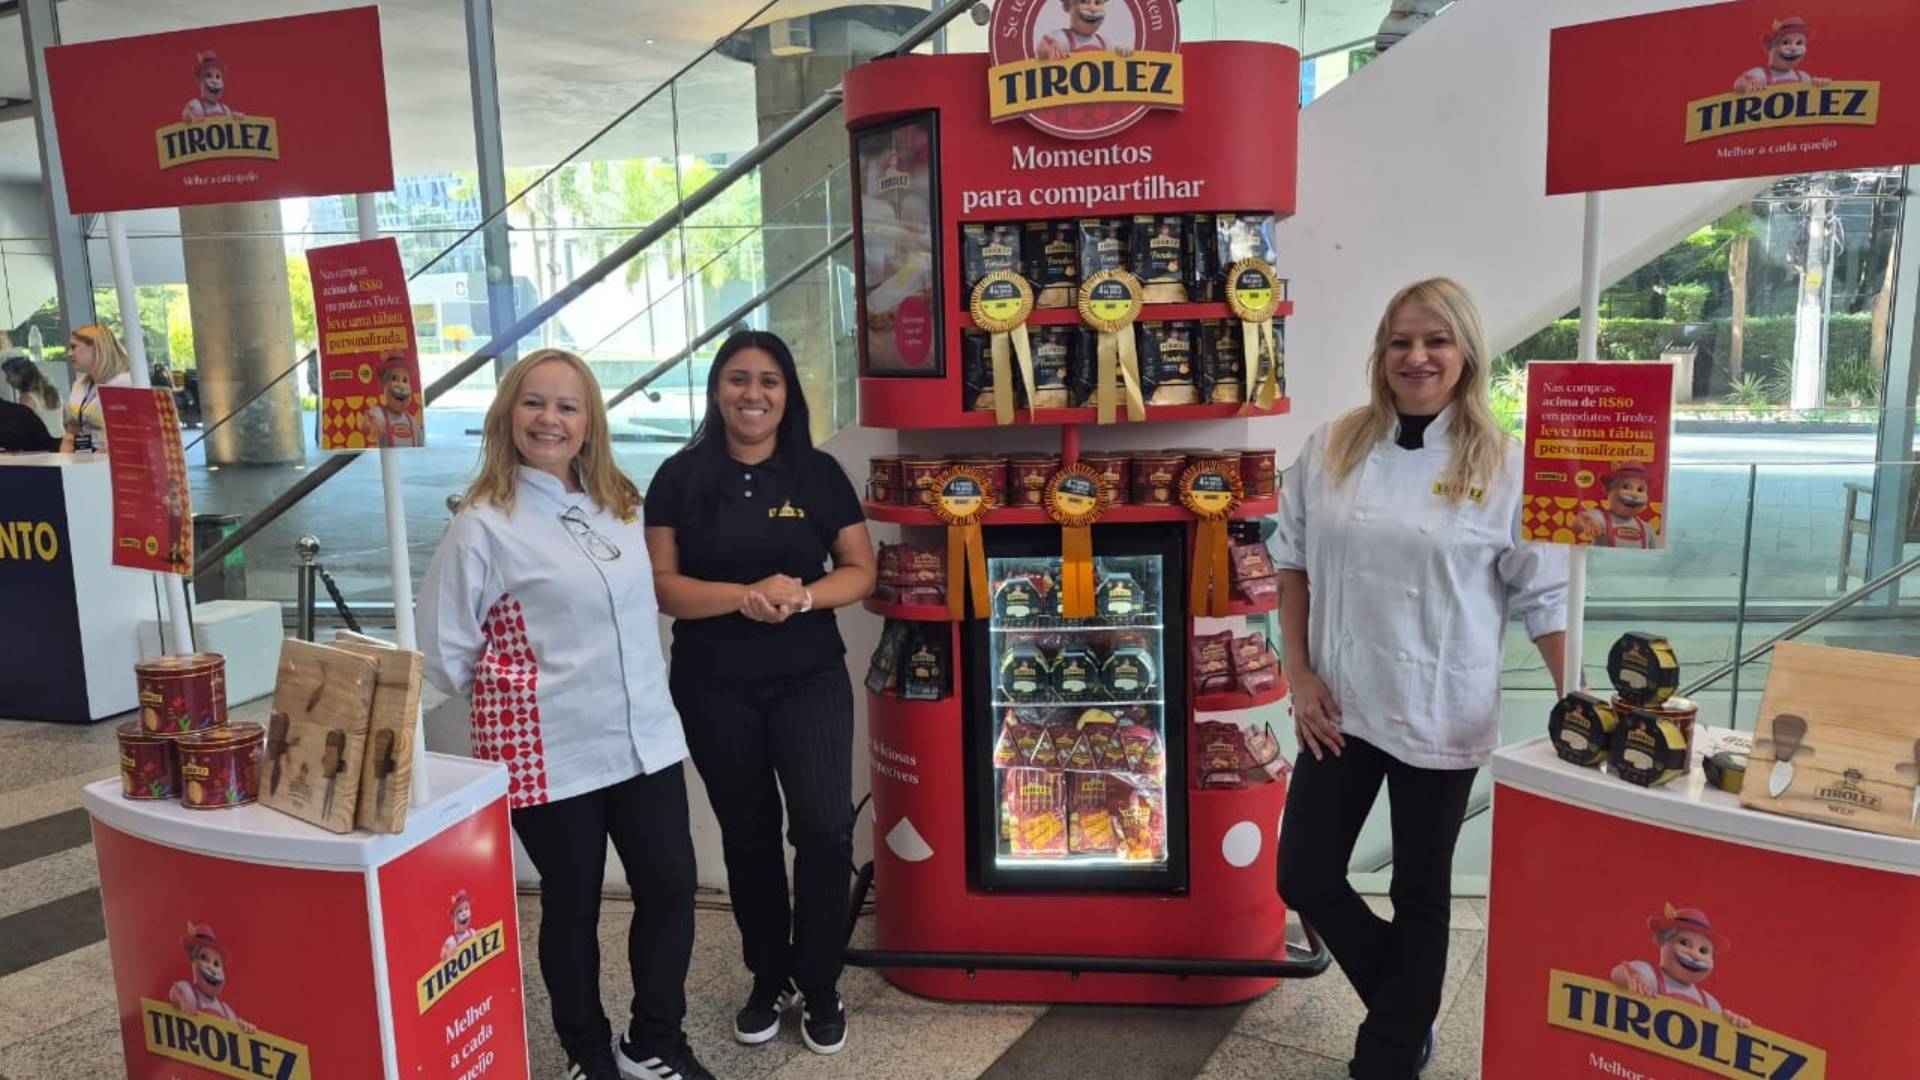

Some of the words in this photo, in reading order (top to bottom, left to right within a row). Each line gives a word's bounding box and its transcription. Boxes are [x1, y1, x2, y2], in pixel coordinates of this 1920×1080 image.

[1003, 16, 1018, 38] Se
[998, 60, 1173, 106] TIROLEZ
[1697, 89, 1868, 132] TIROLEZ
[163, 123, 271, 159] TIROLEZ
[1717, 146, 1756, 158] Melhor
[1769, 142, 1797, 154] cada
[1800, 138, 1837, 152] queijo
[1011, 144, 1153, 170] Momentos
[962, 187, 1023, 213] para
[1029, 175, 1205, 209] compartilhar
[324, 284, 347, 296] acima
[348, 282, 359, 294] de
[338, 299, 373, 312] produtos
[327, 316, 348, 331] leve
[1543, 382, 1564, 393] Nas
[1566, 384, 1616, 395] compras
[1542, 396, 1578, 408] acima
[1580, 396, 1597, 408] de
[1541, 412, 1558, 422] em
[1560, 413, 1611, 423] produtos
[1614, 411, 1657, 424] Tirolez,
[1541, 424, 1570, 438] leve
[1571, 428, 1605, 439] uma
[1609, 426, 1653, 440] tábua
[1539, 442, 1649, 457] personalizada.
[1819, 788, 1878, 807] TIROLEZ
[423, 927, 501, 1001] TIROLEZ
[446, 995, 493, 1045] Melhor
[1562, 982, 1809, 1080] TIROLEZ
[147, 1009, 298, 1080] TIROLEZ
[450, 1053, 460, 1069] a
[462, 1023, 493, 1059] cada
[1589, 1052, 1645, 1080] Melhor
